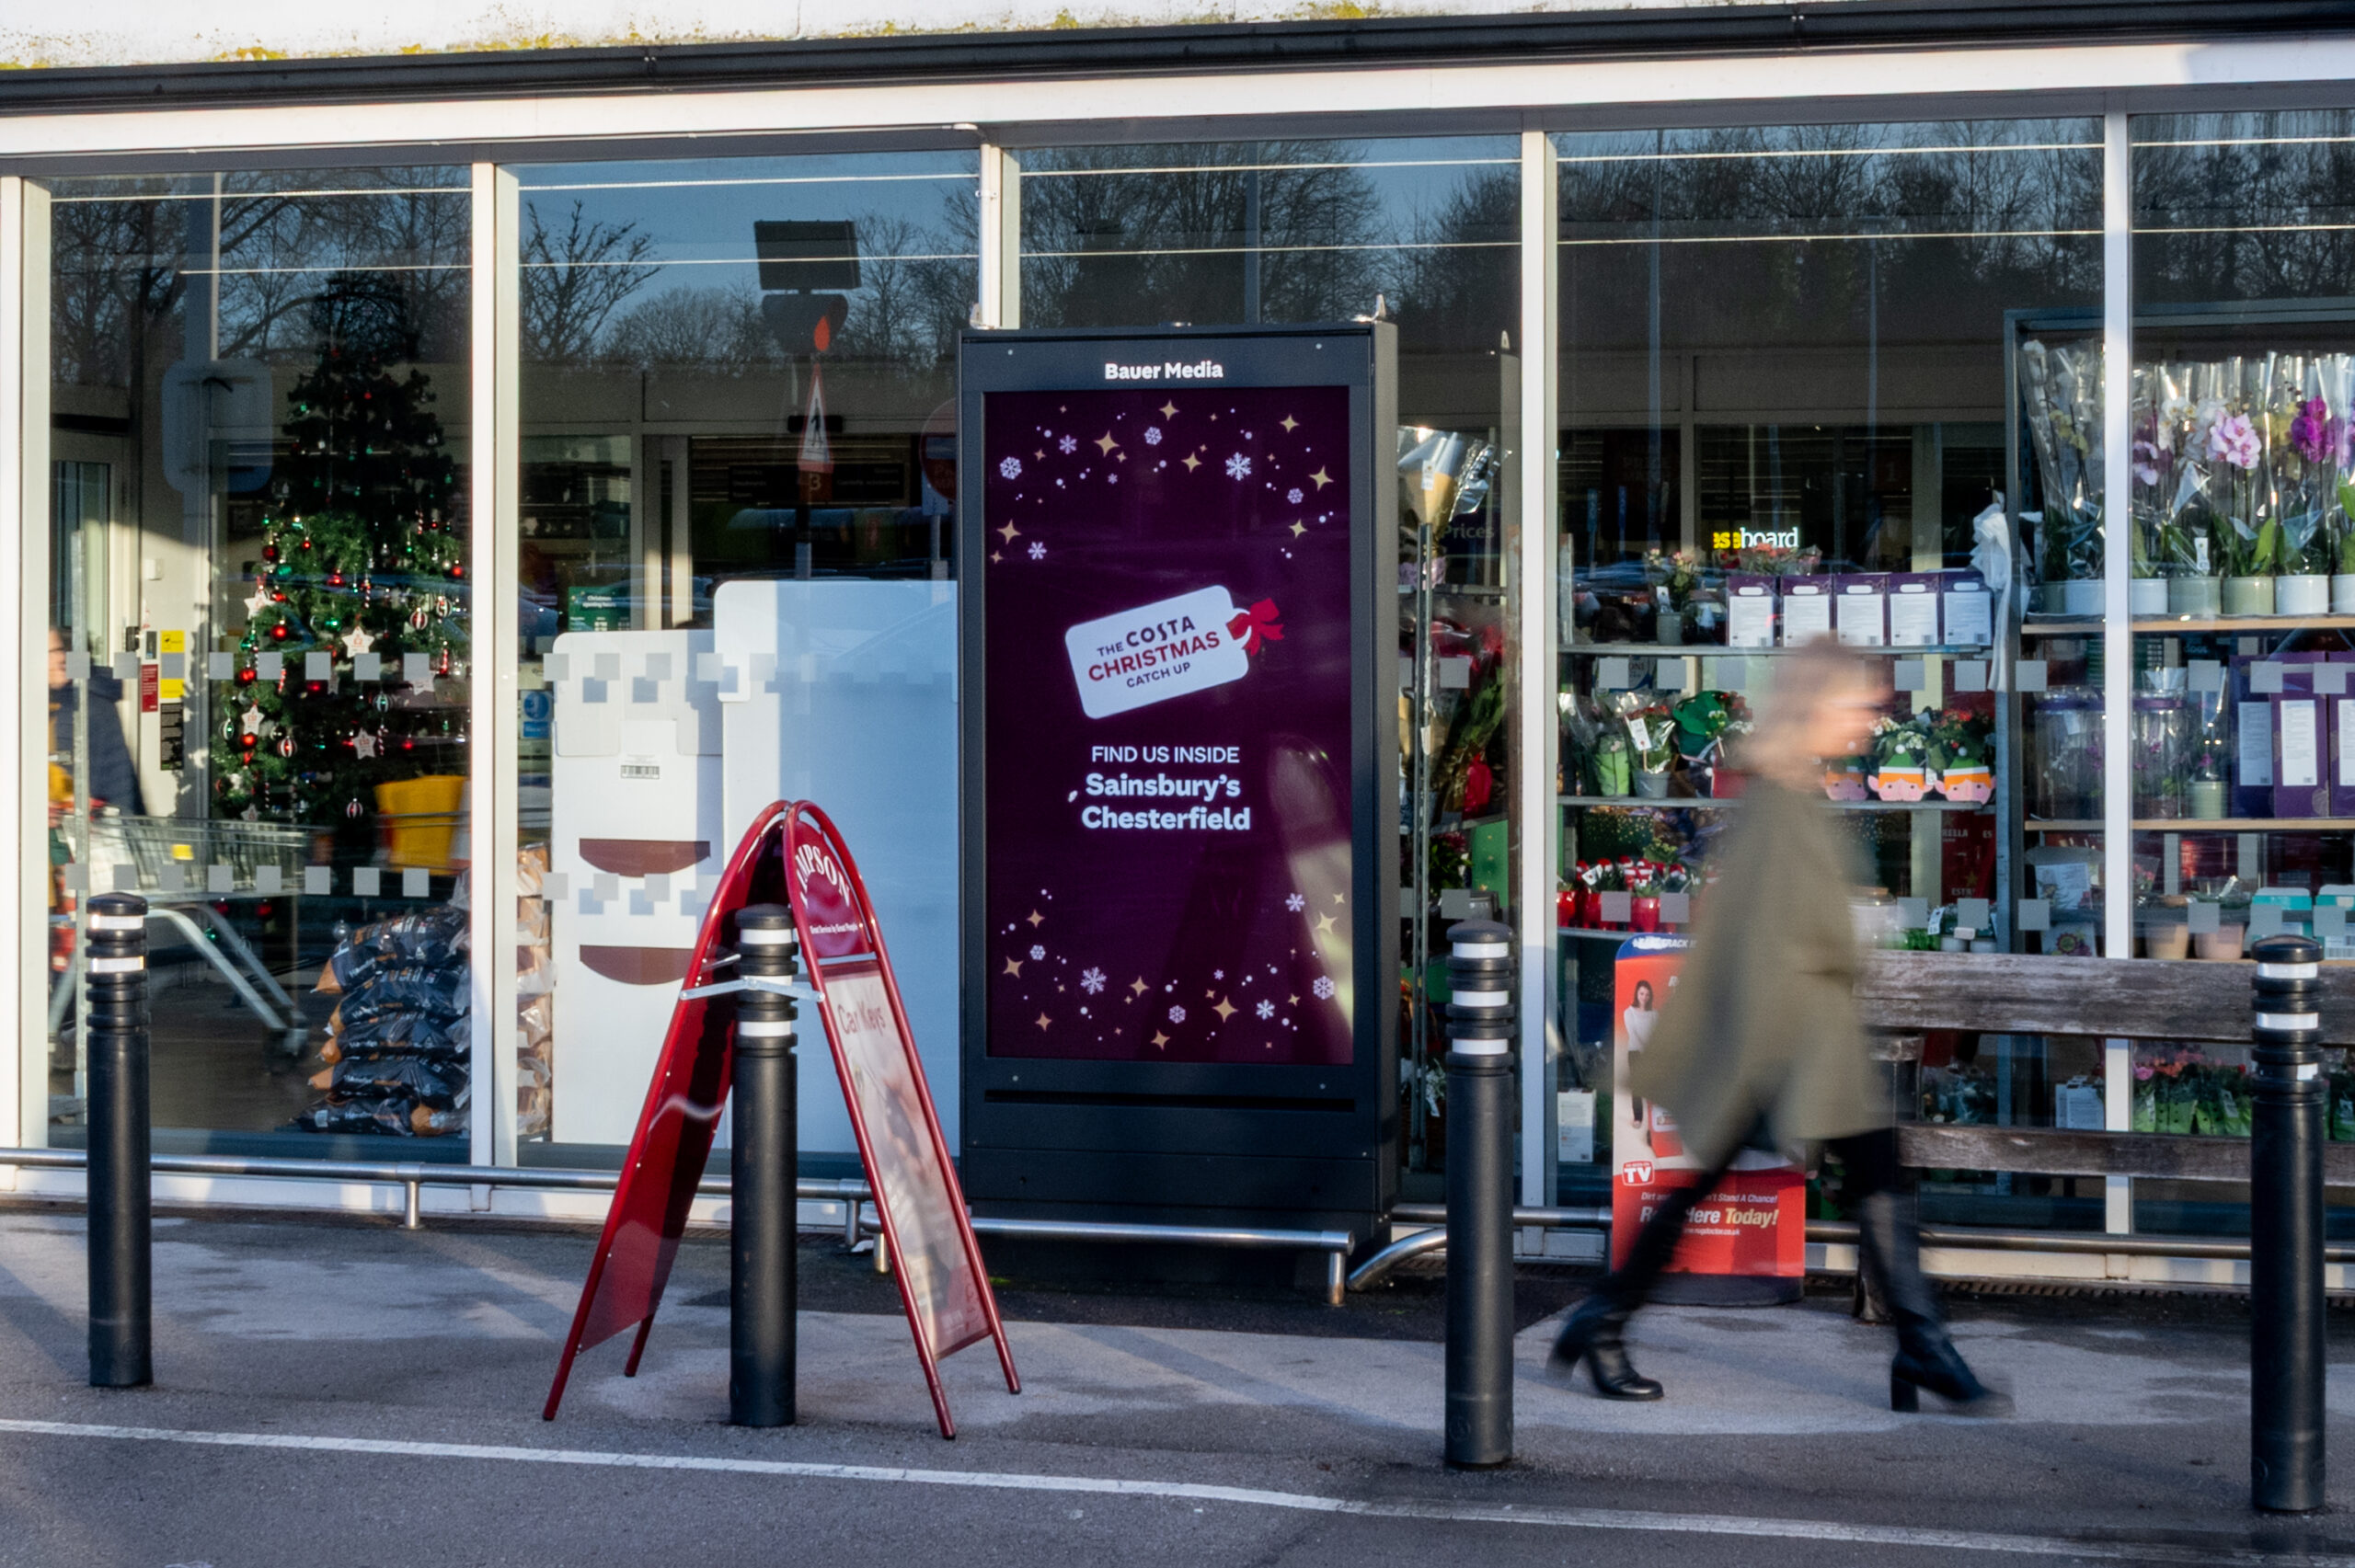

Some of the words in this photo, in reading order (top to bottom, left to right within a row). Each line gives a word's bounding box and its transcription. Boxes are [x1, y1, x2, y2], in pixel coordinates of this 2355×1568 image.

[1104, 362, 1161, 381] Bauer
[1164, 361, 1223, 380] Media
[1097, 641, 1124, 658] THE
[1125, 615, 1196, 647] COSTA
[1087, 631, 1221, 681] CHRISTMAS
[1126, 667, 1170, 688] CATCH
[1172, 661, 1191, 676] UP
[1091, 746, 1138, 763] FIND
[1142, 746, 1170, 763] US
[1173, 746, 1240, 763] INSIDE
[1086, 773, 1241, 802] Sainsbury's
[1081, 806, 1251, 830] Chesterfield
[837, 1003, 859, 1035] Car
[857, 1000, 886, 1036] Keys
[1624, 1167, 1651, 1184] TV
[1717, 1194, 1740, 1203] Stand
[1740, 1194, 1747, 1203] A
[1747, 1195, 1778, 1204] Chance!
[1725, 1207, 1779, 1229] Today!
